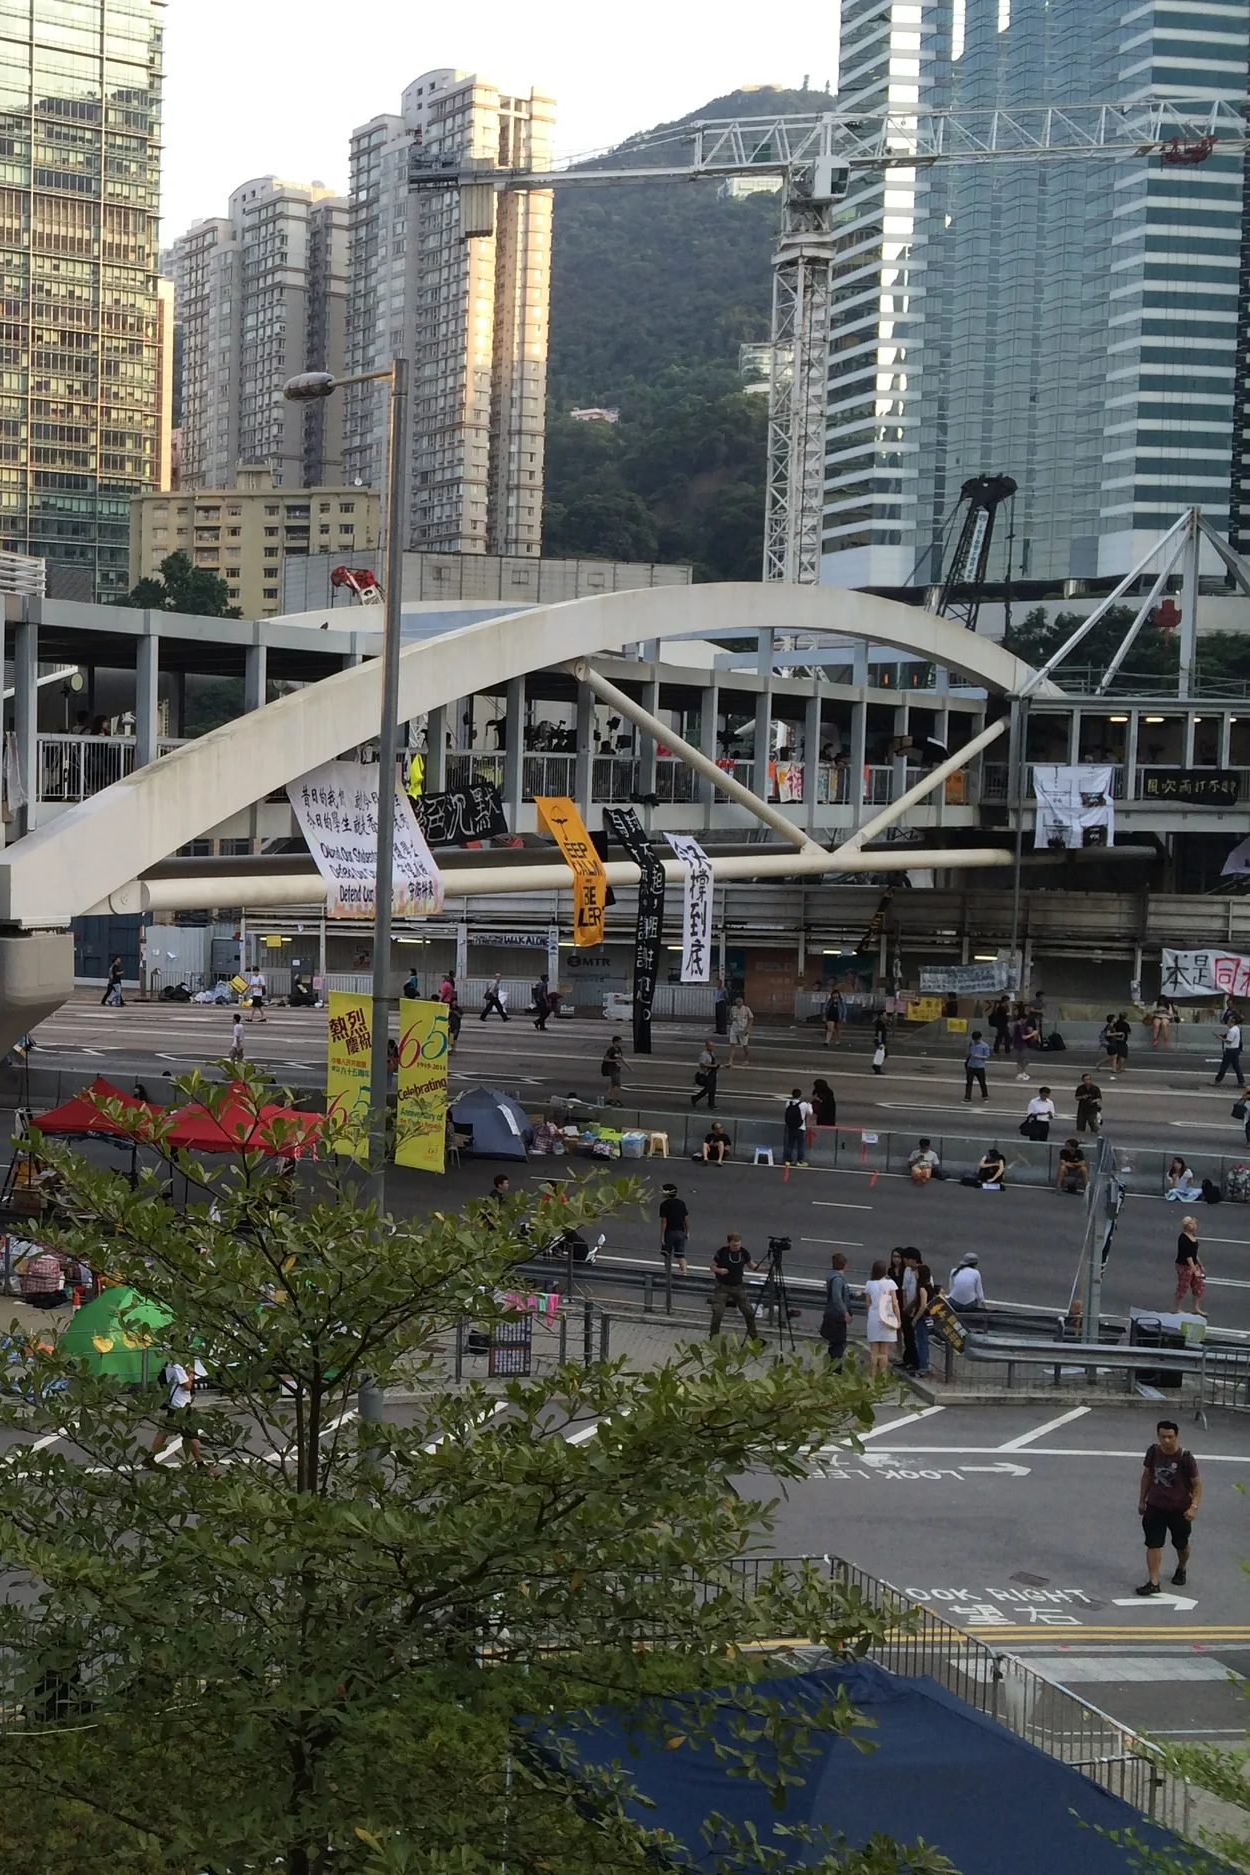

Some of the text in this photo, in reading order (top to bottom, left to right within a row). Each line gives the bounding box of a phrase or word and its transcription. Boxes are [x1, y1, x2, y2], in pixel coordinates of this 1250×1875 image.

[563, 842, 588, 859] EEP
[583, 958, 611, 967] MTR
[329, 1007, 368, 1043] 熱烈
[346, 1031, 372, 1055] 慶祝
[398, 1015, 448, 1069] 65
[416, 1062, 446, 1071] 1949-2014
[398, 1078, 447, 1101] Celebrating
[436, 1113, 444, 1122] of
[799, 1469, 965, 1480] LOOK LEF
[985, 1587, 1091, 1603] RIGHT
[948, 1604, 1083, 1625] 望右
